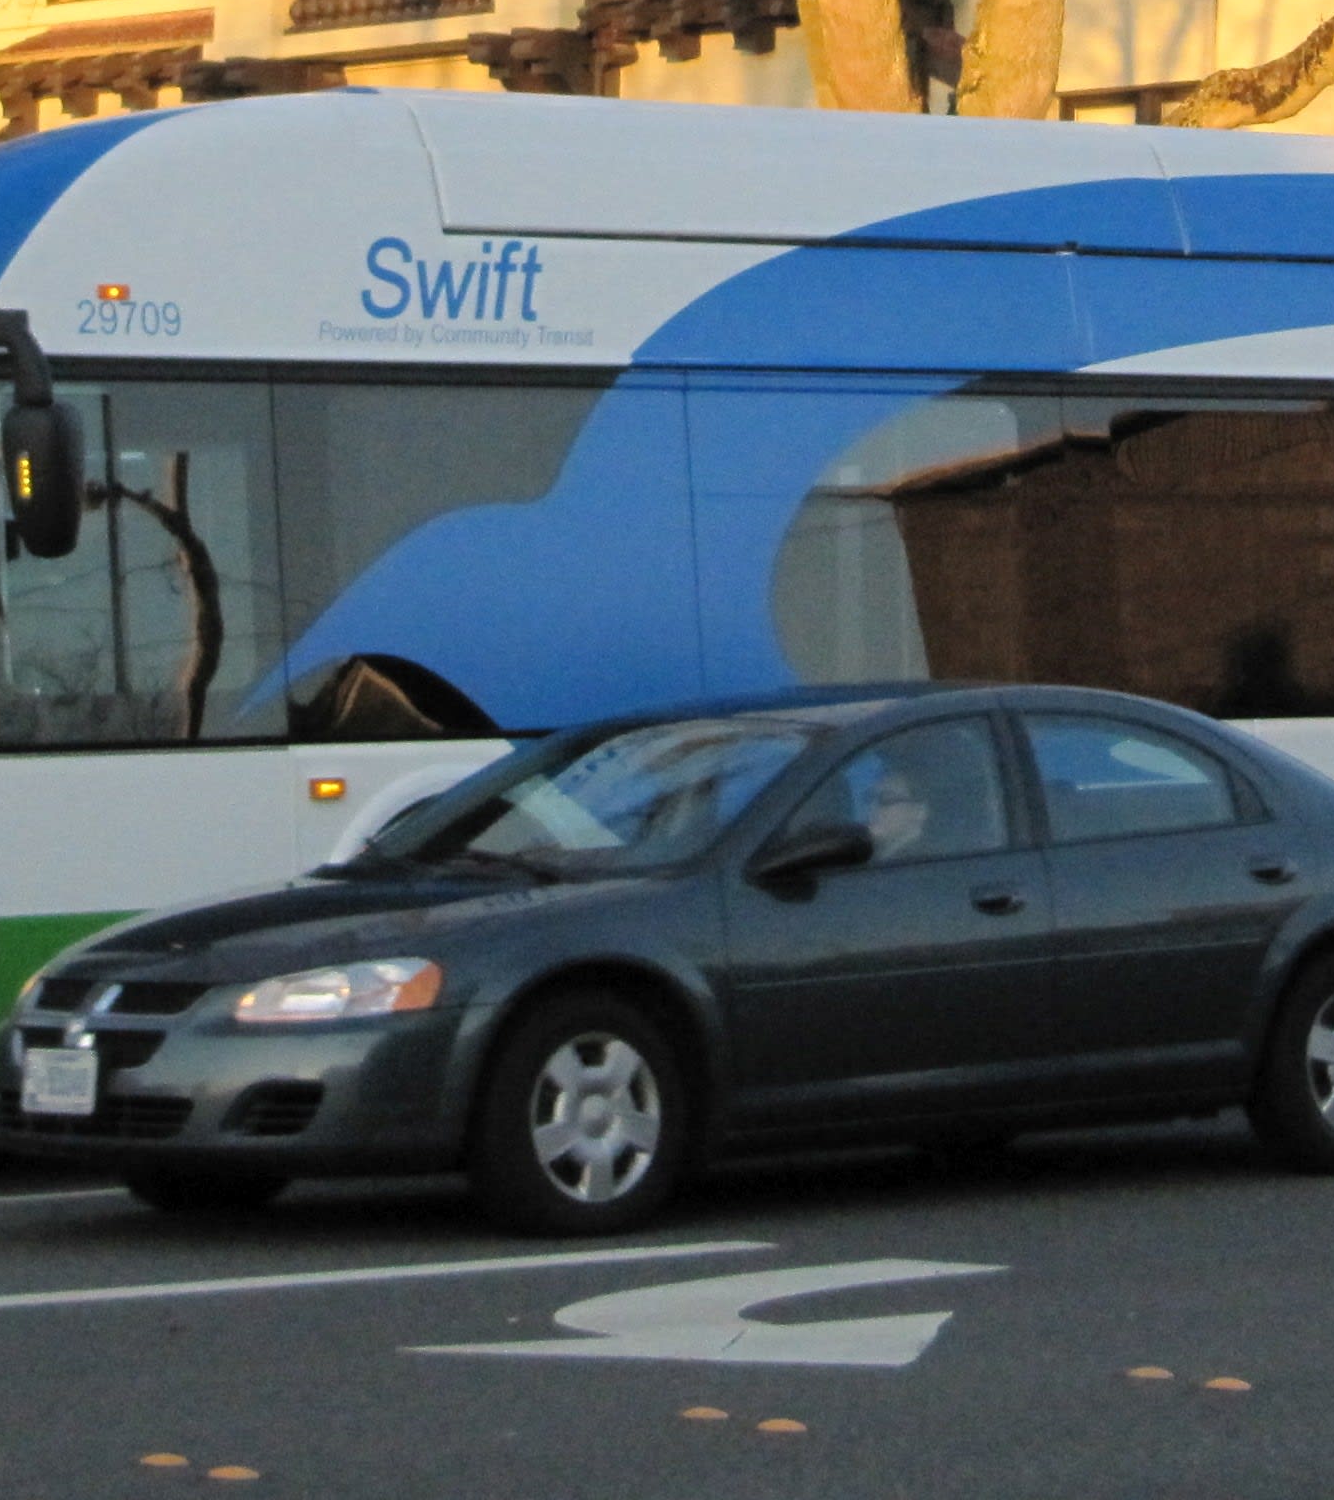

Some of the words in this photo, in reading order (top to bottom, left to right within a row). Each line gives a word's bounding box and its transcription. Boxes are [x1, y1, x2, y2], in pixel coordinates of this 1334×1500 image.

[361, 236, 542, 323] Swift
[76, 299, 183, 337] 29709
[318, 320, 398, 344] Powered
[403, 322, 424, 348] by
[430, 323, 531, 349] Community
[537, 325, 595, 347] Transit
